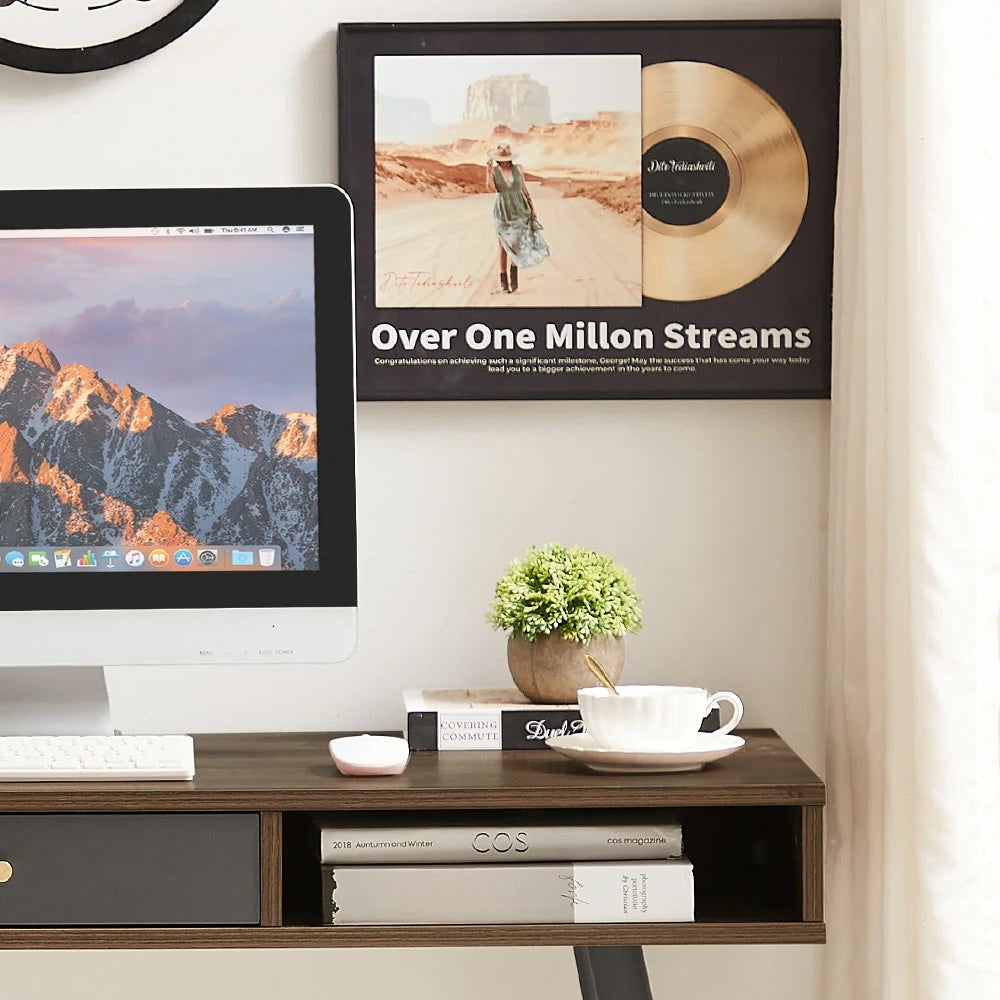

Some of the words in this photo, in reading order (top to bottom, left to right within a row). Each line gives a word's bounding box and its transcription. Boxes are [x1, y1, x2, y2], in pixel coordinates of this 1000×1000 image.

[371, 323, 458, 351] Over
[464, 323, 537, 351] One
[545, 320, 655, 351] Millon
[663, 322, 812, 350] Streams
[374, 357, 437, 366] Congratulations
[450, 357, 487, 366] achieving
[489, 357, 508, 365] such
[515, 357, 557, 366] significant
[558, 357, 599, 366] milestone,
[632, 357, 648, 366] May
[649, 357, 662, 365] the
[752, 358, 770, 366] your
[788, 356, 811, 365] today
[506, 367, 521, 375] you
[538, 365, 564, 375] bigger
[565, 365, 616, 373] achievement
[440, 720, 498, 730] COVERING
[442, 732, 500, 741] COMMUTE
[333, 841, 352, 849] 2018
[391, 840, 407, 848] and
[407, 840, 434, 848] Winter
[471, 832, 529, 853] COS
[624, 836, 667, 846] magazine
